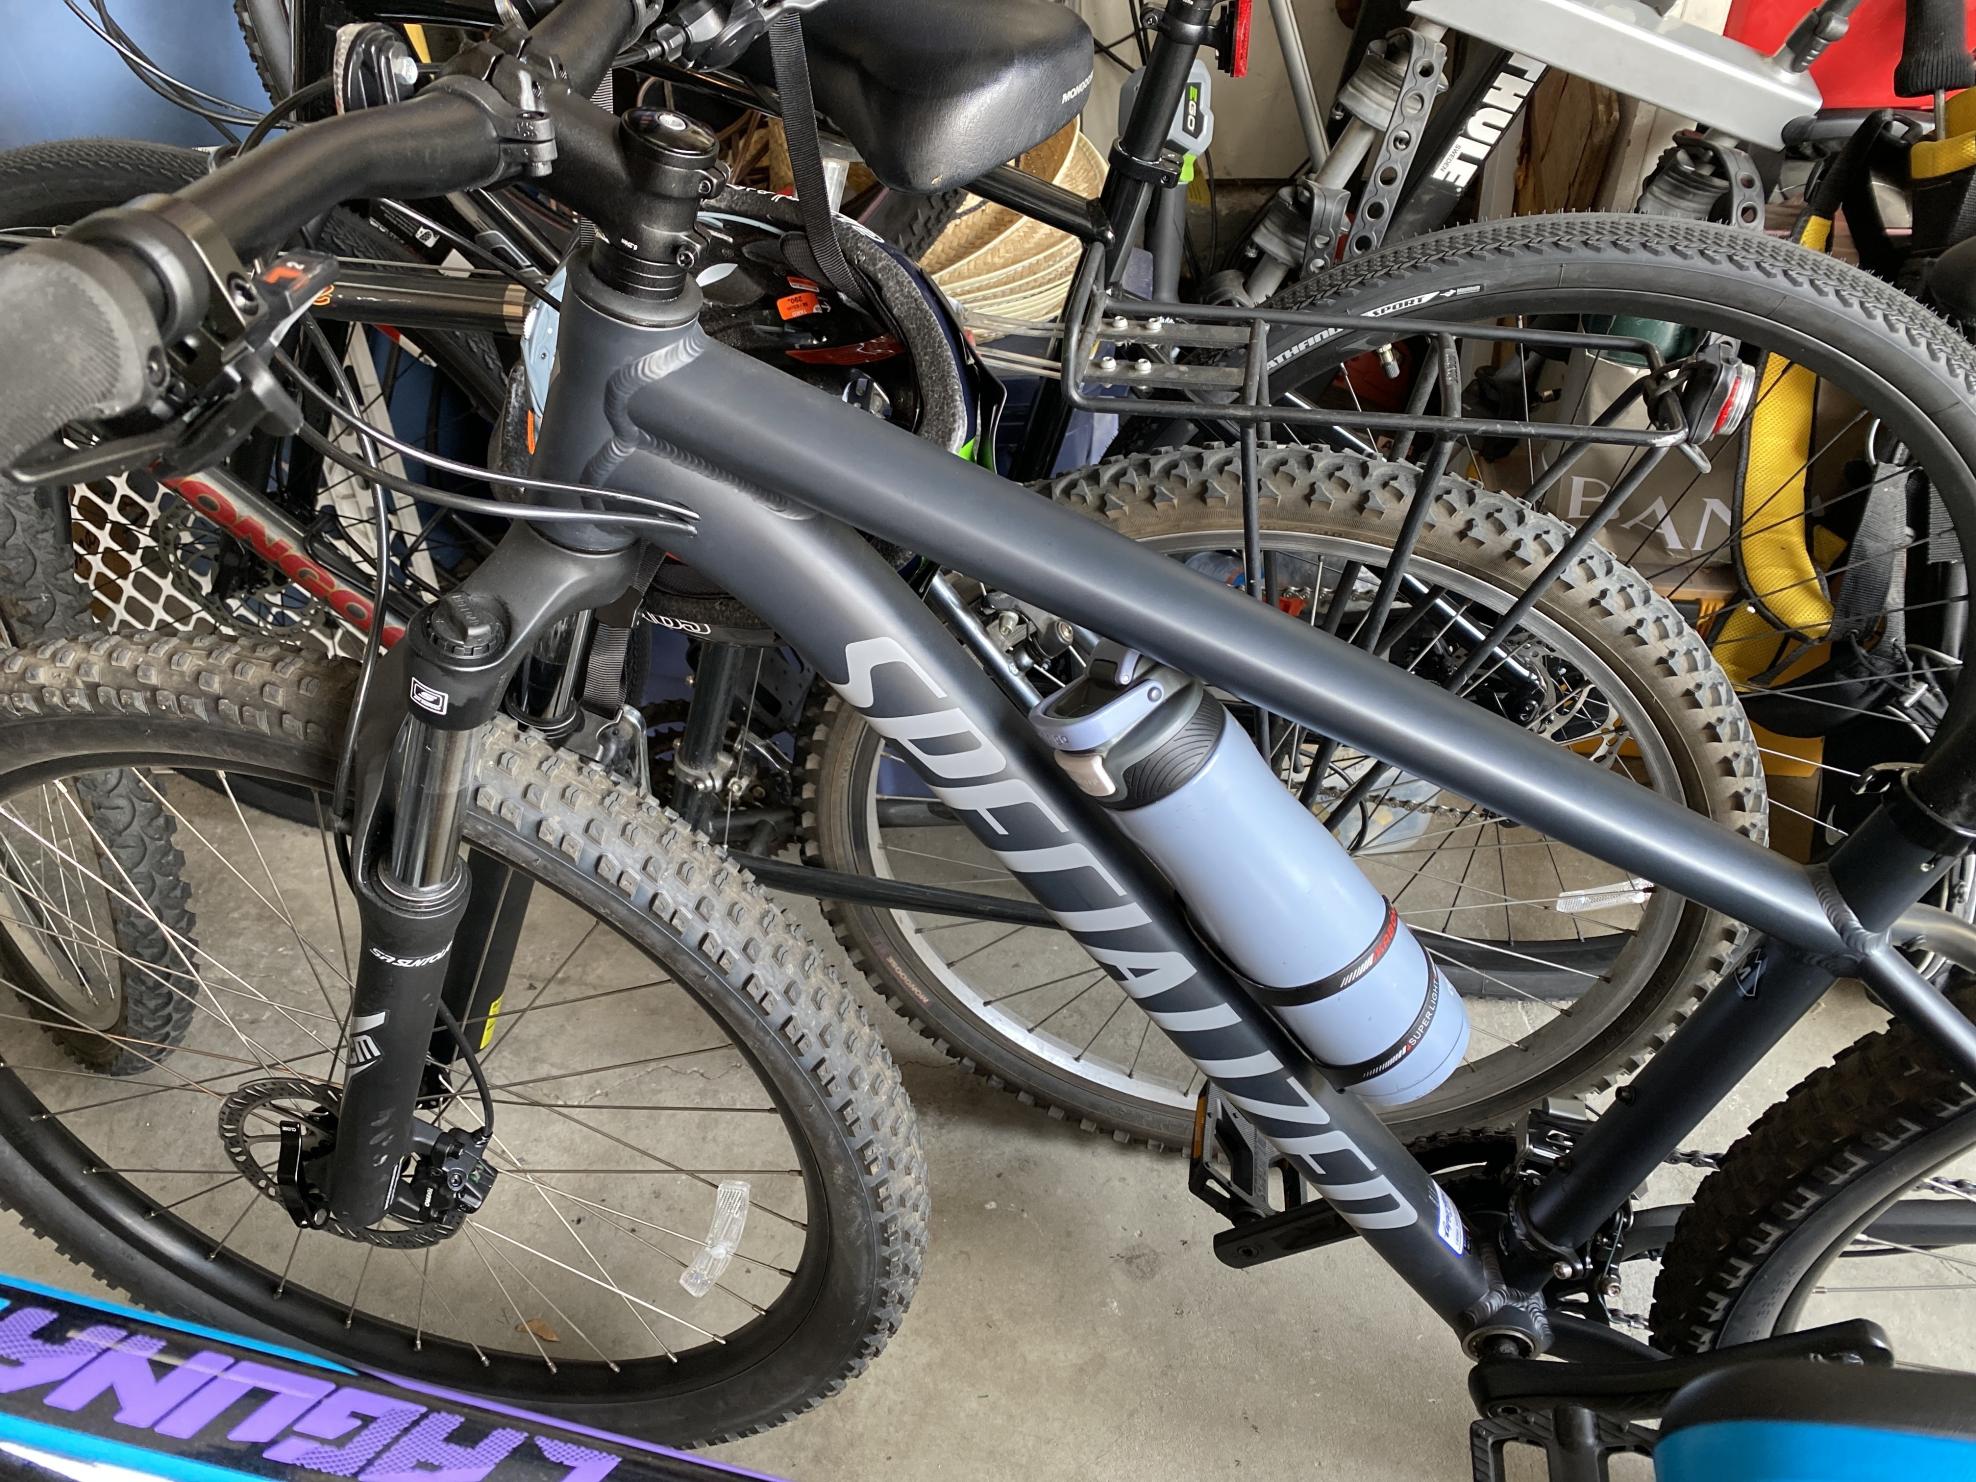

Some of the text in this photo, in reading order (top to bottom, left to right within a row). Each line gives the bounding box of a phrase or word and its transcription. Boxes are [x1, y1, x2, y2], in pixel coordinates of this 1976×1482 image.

[1186, 85, 1199, 132] EGO
[1432, 53, 1547, 186] THULE
[1438, 143, 1461, 173] SWEDEN
[1371, 295, 1425, 318] SPORT
[1266, 327, 1343, 371] ATHFIN
[393, 940, 453, 967] SUNTOU
[832, 634, 1418, 1231] SPECIALIZED
[887, 955, 930, 1004] MONGOOSE
